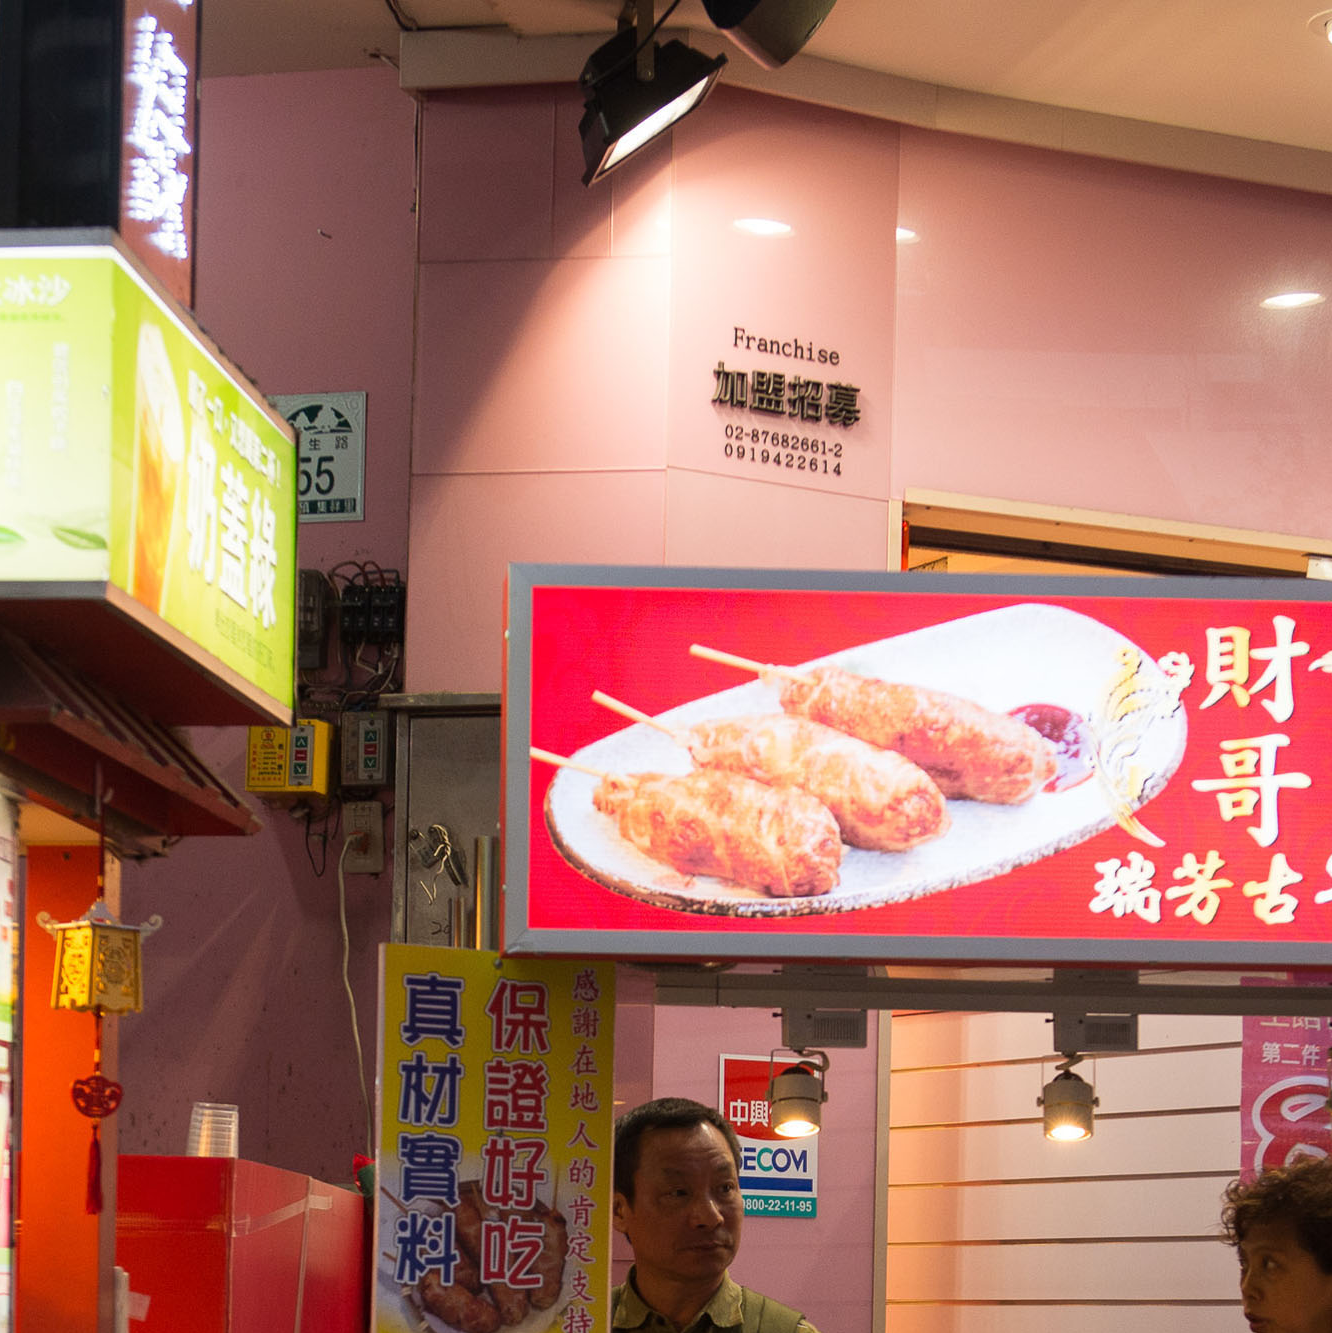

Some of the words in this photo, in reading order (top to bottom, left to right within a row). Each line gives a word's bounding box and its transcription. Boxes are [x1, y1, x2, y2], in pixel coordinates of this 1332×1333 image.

[733, 326, 840, 366] Franchise
[711, 360, 861, 427] 加盟招募
[724, 423, 843, 458] 02-87682661-2
[724, 442, 842, 476] 0919422614
[1190, 614, 1312, 848] 財哥
[393, 971, 466, 1287] 真材實料
[729, 1098, 773, 1128] 中興
[480, 977, 550, 1290] 保證好吃
[739, 1146, 807, 1174] ECOM
